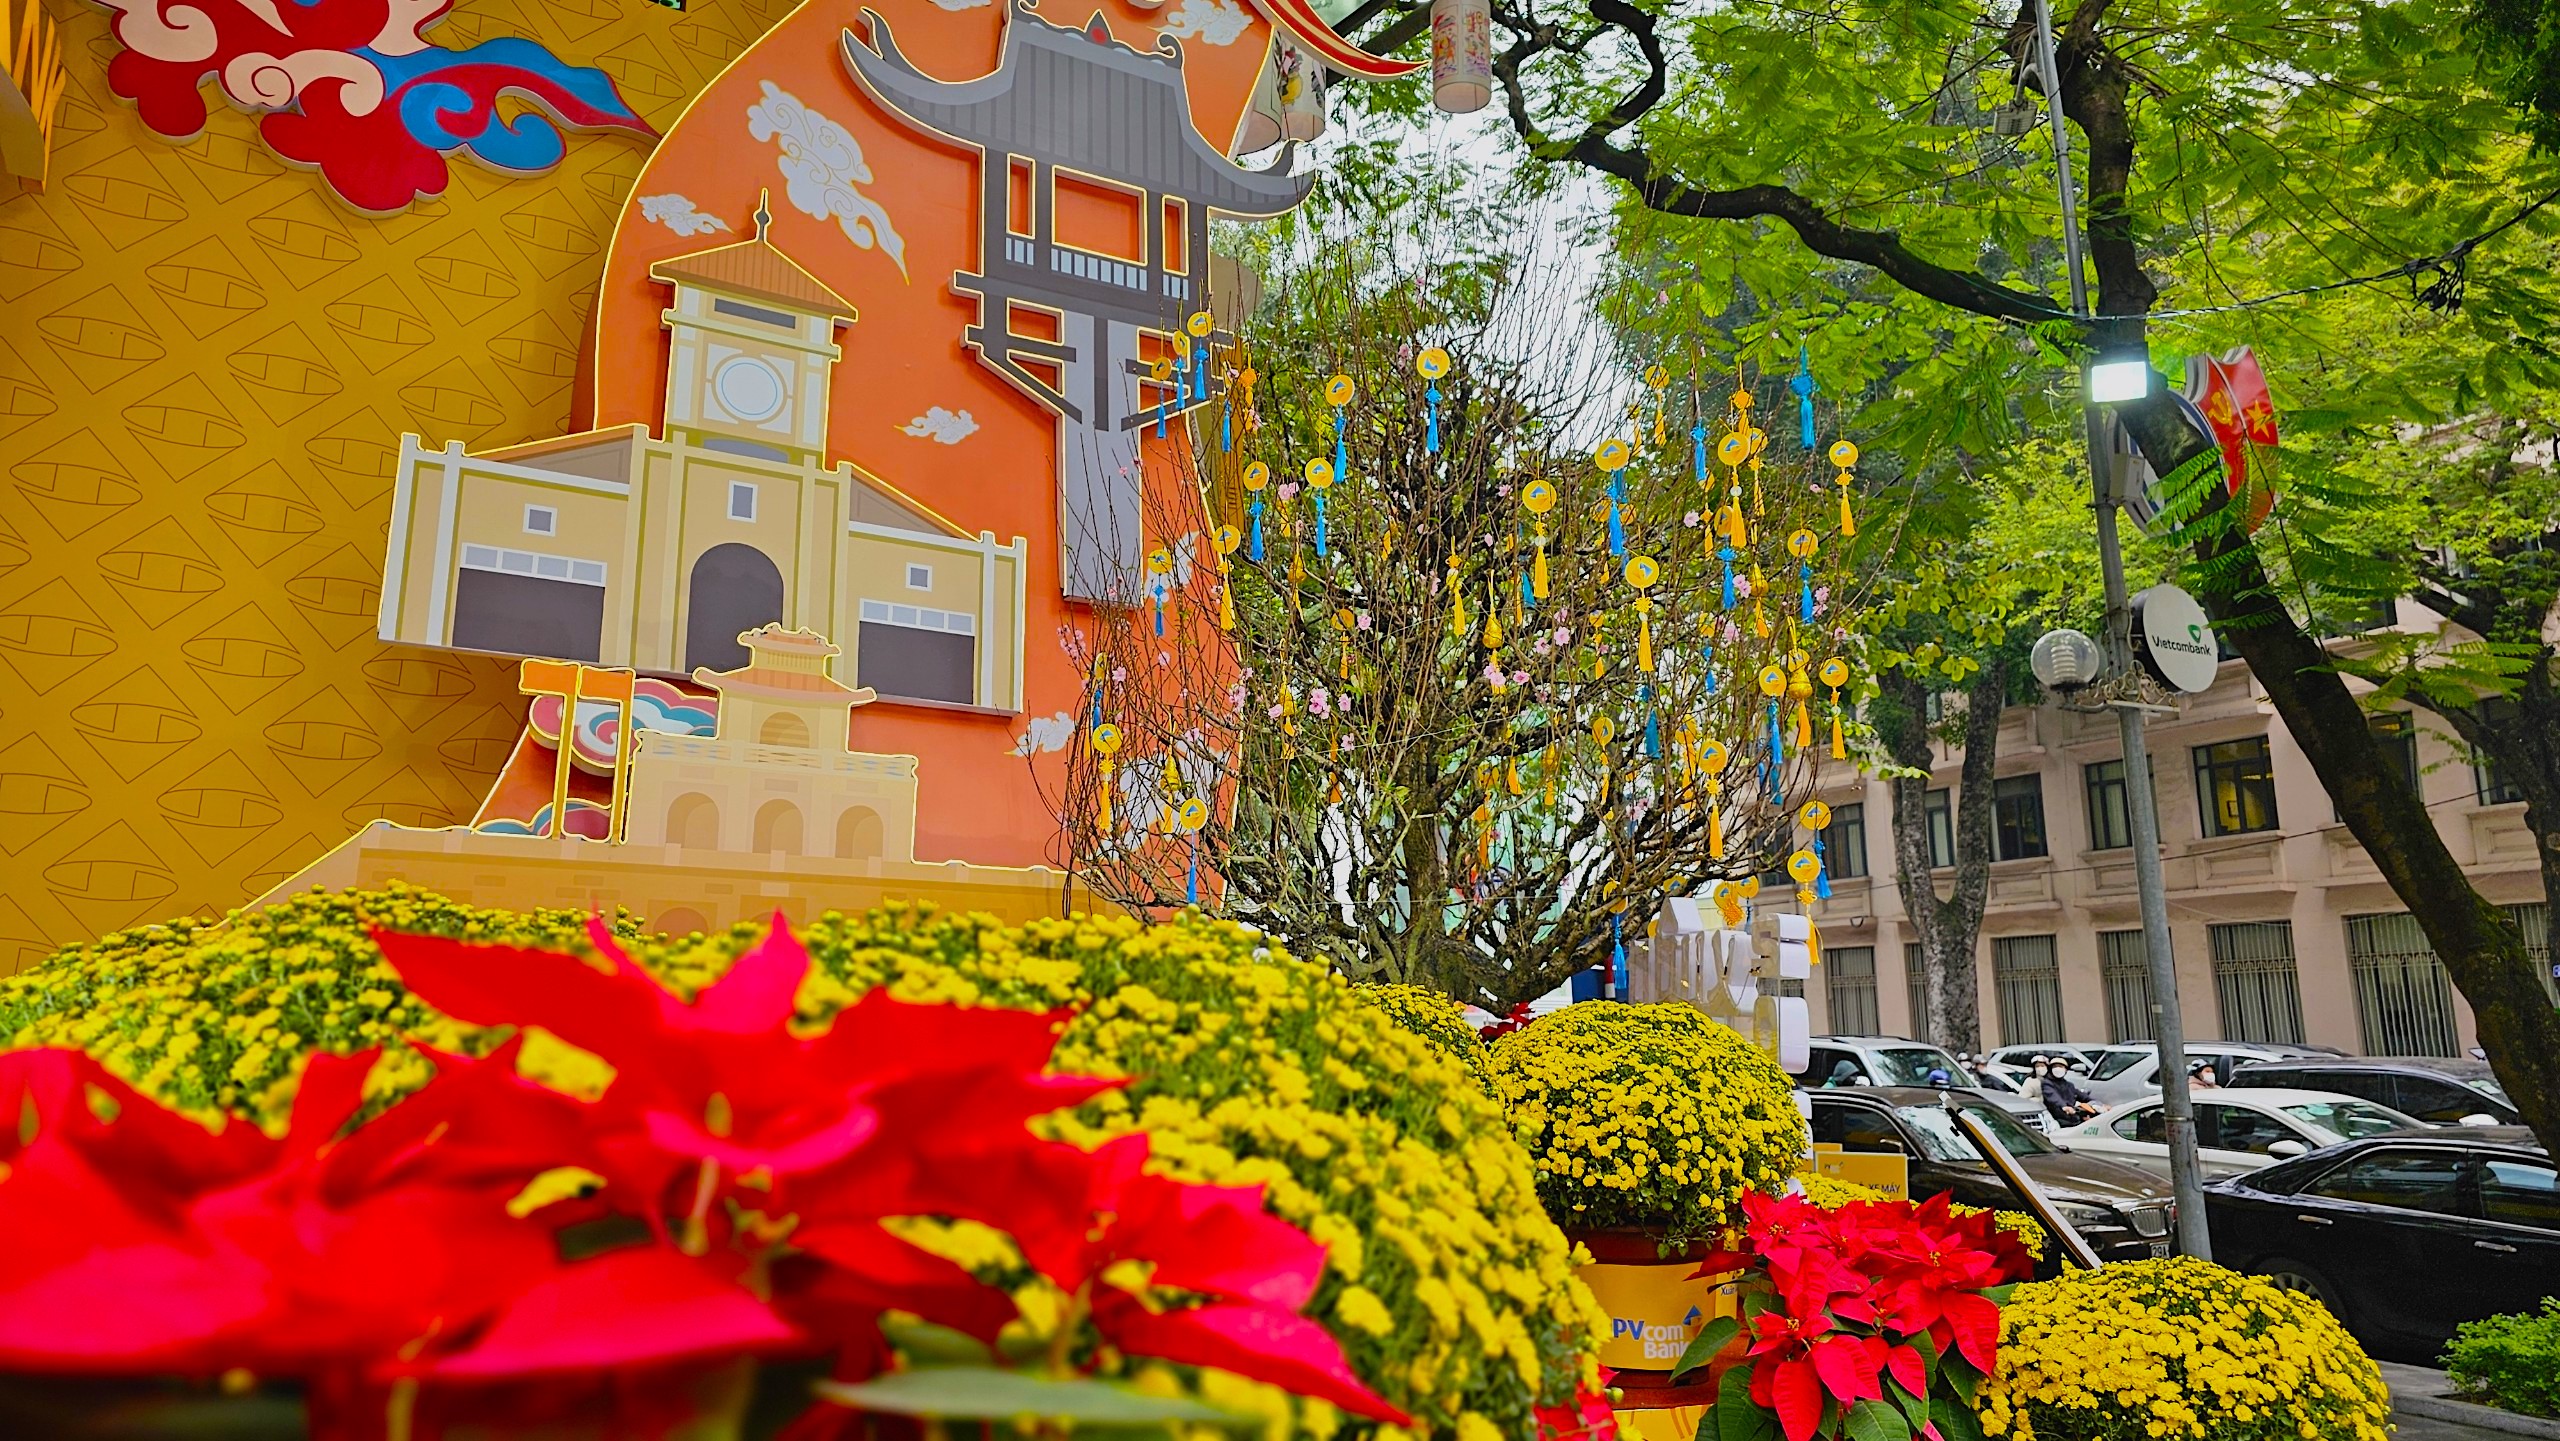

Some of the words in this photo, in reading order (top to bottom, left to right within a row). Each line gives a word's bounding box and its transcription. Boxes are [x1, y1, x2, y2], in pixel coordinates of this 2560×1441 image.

[2152, 635, 2211, 656] Vietcombank
[1881, 1181, 1901, 1194] MÁY
[1612, 1317, 1684, 1341] PVcom
